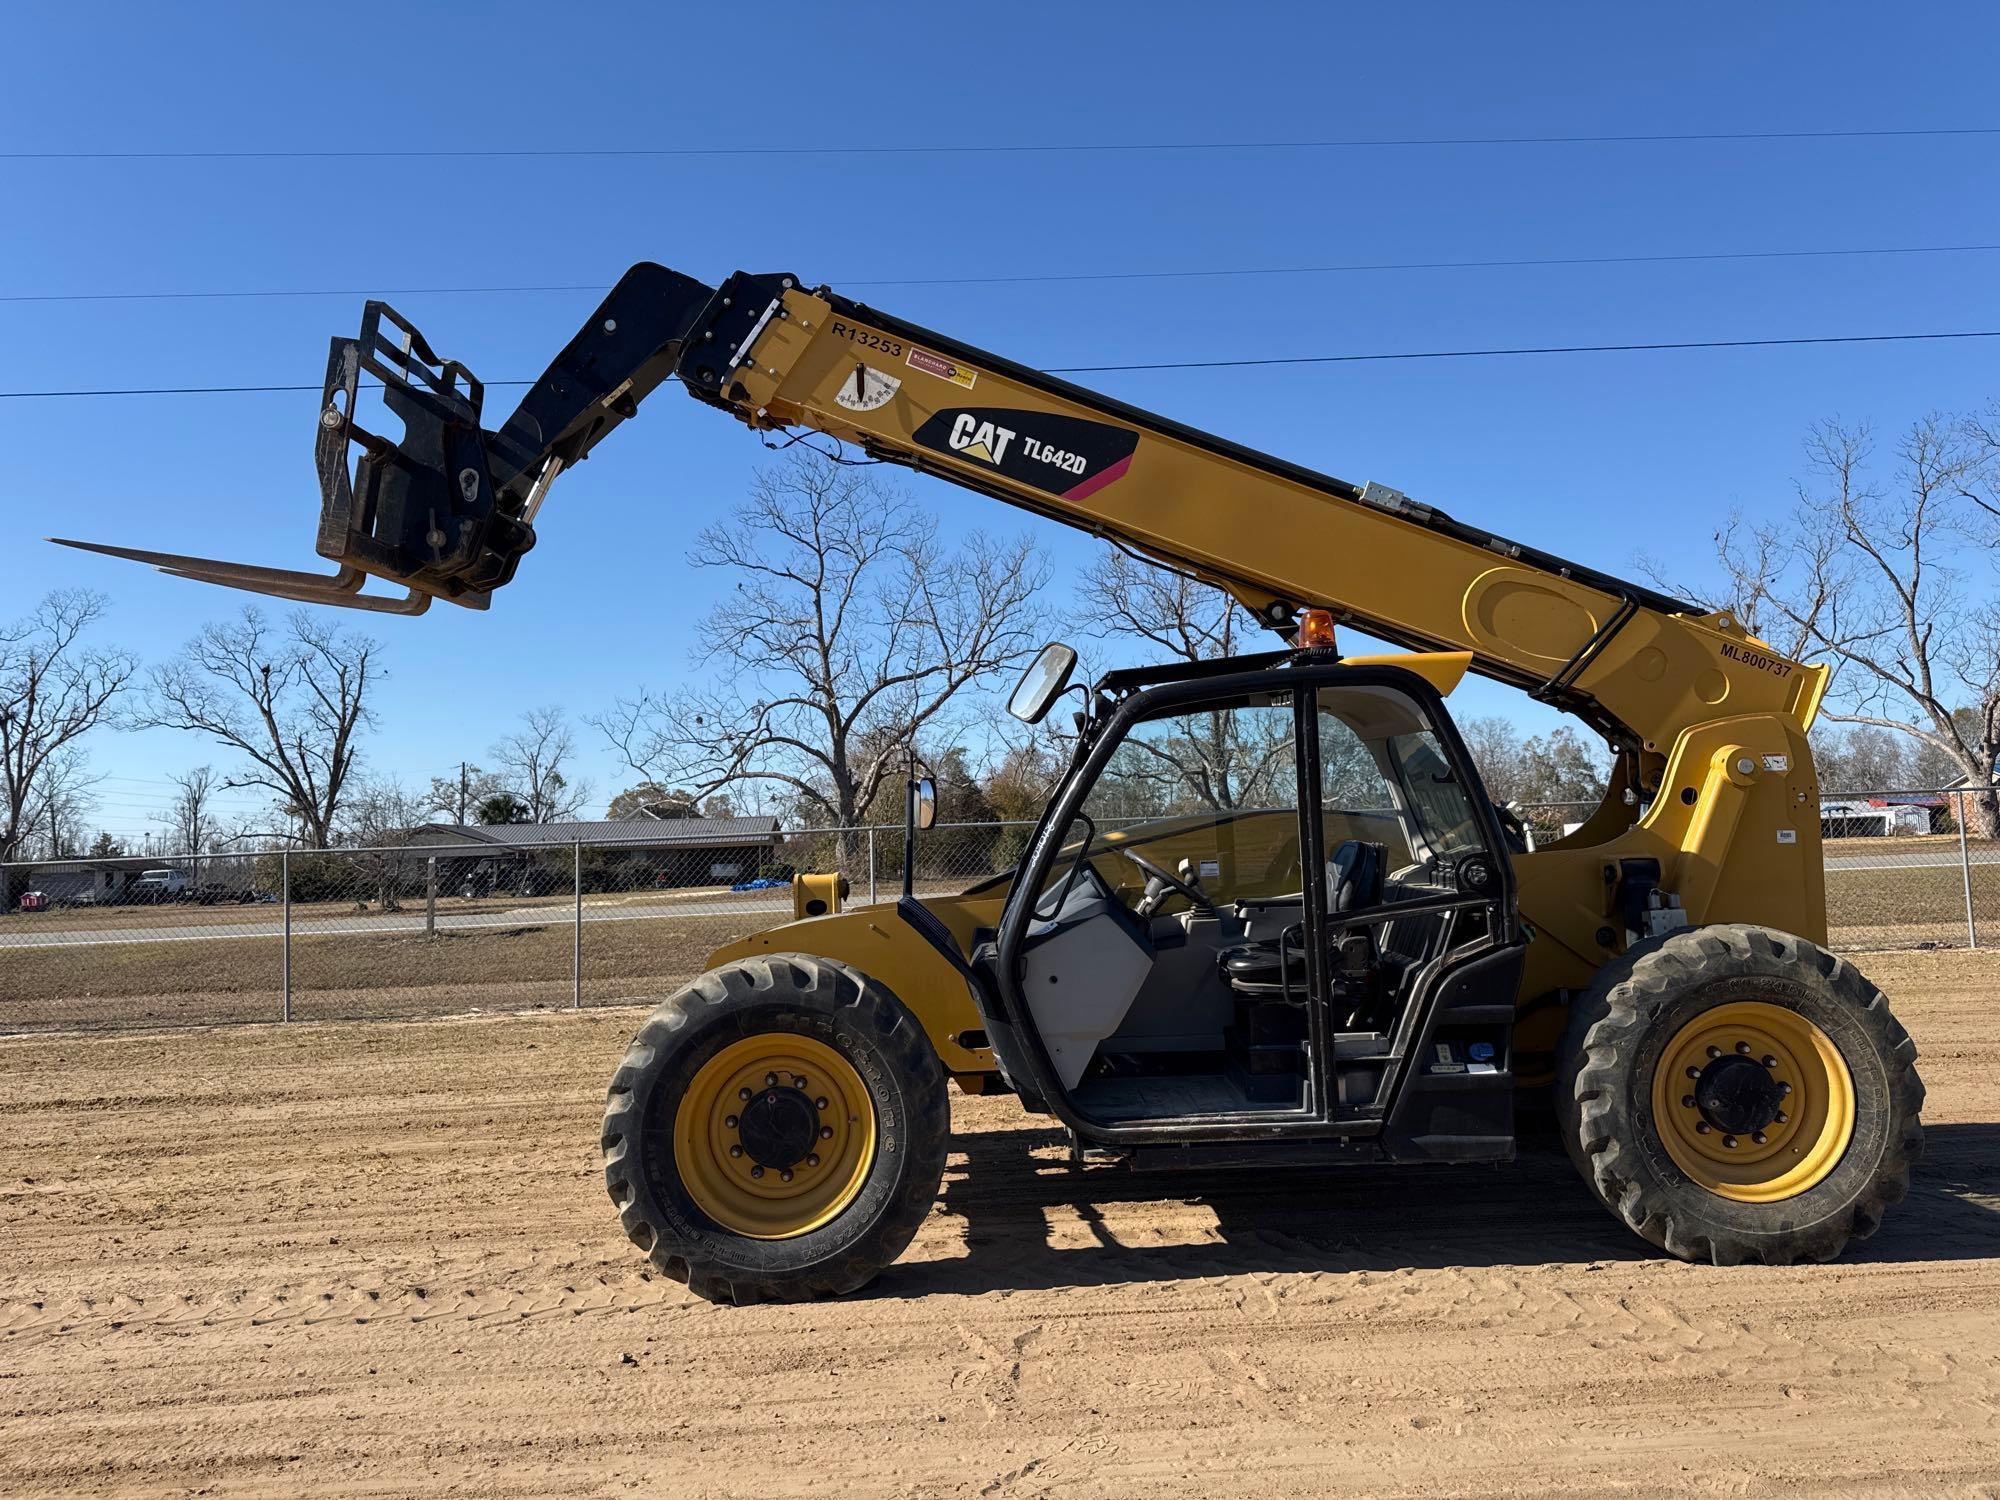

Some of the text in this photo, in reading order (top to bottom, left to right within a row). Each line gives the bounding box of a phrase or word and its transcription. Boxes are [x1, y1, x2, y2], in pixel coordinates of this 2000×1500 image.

[831, 322, 902, 357] R13253
[948, 413, 1017, 466] CAT
[1023, 436, 1087, 475] TL642D
[1720, 643, 1792, 678] ML800737
